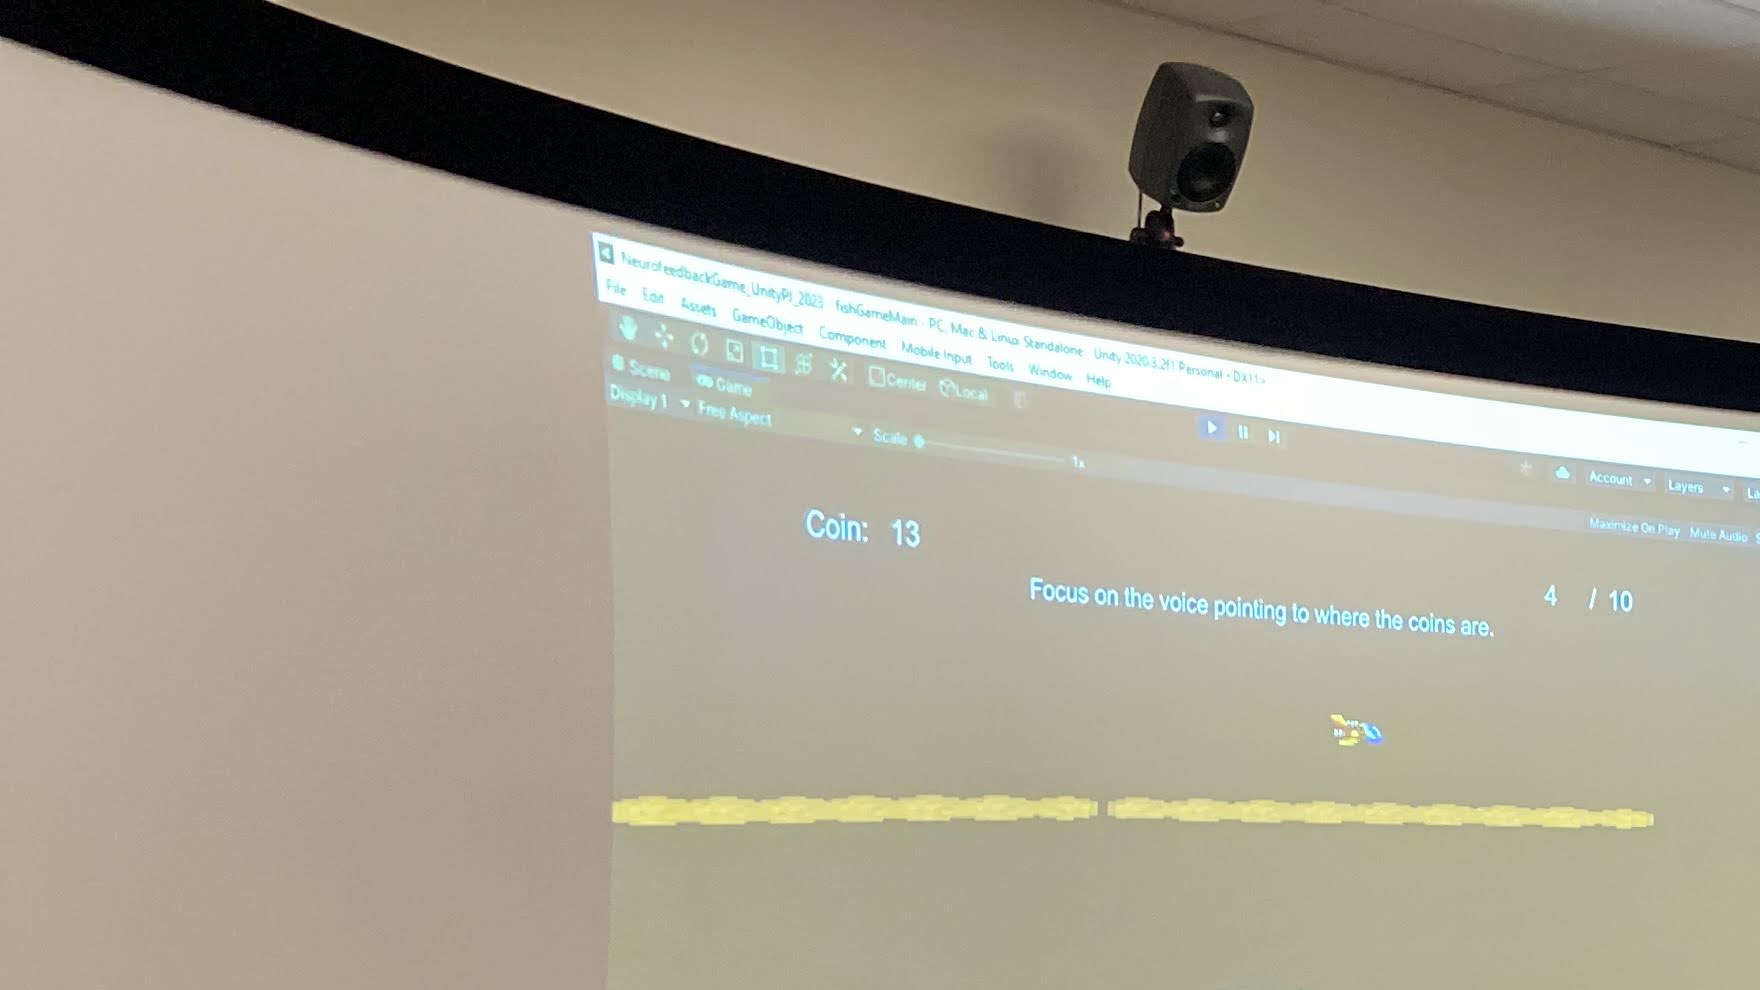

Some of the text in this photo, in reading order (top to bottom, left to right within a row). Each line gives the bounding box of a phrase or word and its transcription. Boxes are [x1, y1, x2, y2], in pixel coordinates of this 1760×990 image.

[606, 278, 1112, 389] File Edit Assets GameObject Component Mobile Input Tools Window Help
[836, 299, 918, 327] fishGameMain
[951, 321, 974, 338] Mac
[978, 326, 987, 340] &
[992, 331, 1020, 345] Linux
[1024, 335, 1084, 358] Standalone
[1094, 347, 1121, 365] Unity
[1179, 360, 1223, 380] Personal
[629, 359, 753, 397] Scene Game
[887, 371, 989, 401] Center Local
[610, 383, 668, 411] Display 1
[698, 399, 772, 427] Free Aspect
[873, 426, 909, 446] Scale
[1072, 455, 1086, 470] 1x
[1589, 469, 1633, 487] Account
[1668, 479, 1704, 495] Layers
[804, 507, 921, 548] Coin: 13
[1589, 516, 1681, 539] Maximize On Play
[1690, 526, 1748, 544] Mute Audio
[1029, 577, 1495, 638] Focus on the voice pointing to where the coins are.
[1544, 584, 1558, 607] 4
[1608, 589, 1634, 613] 10
